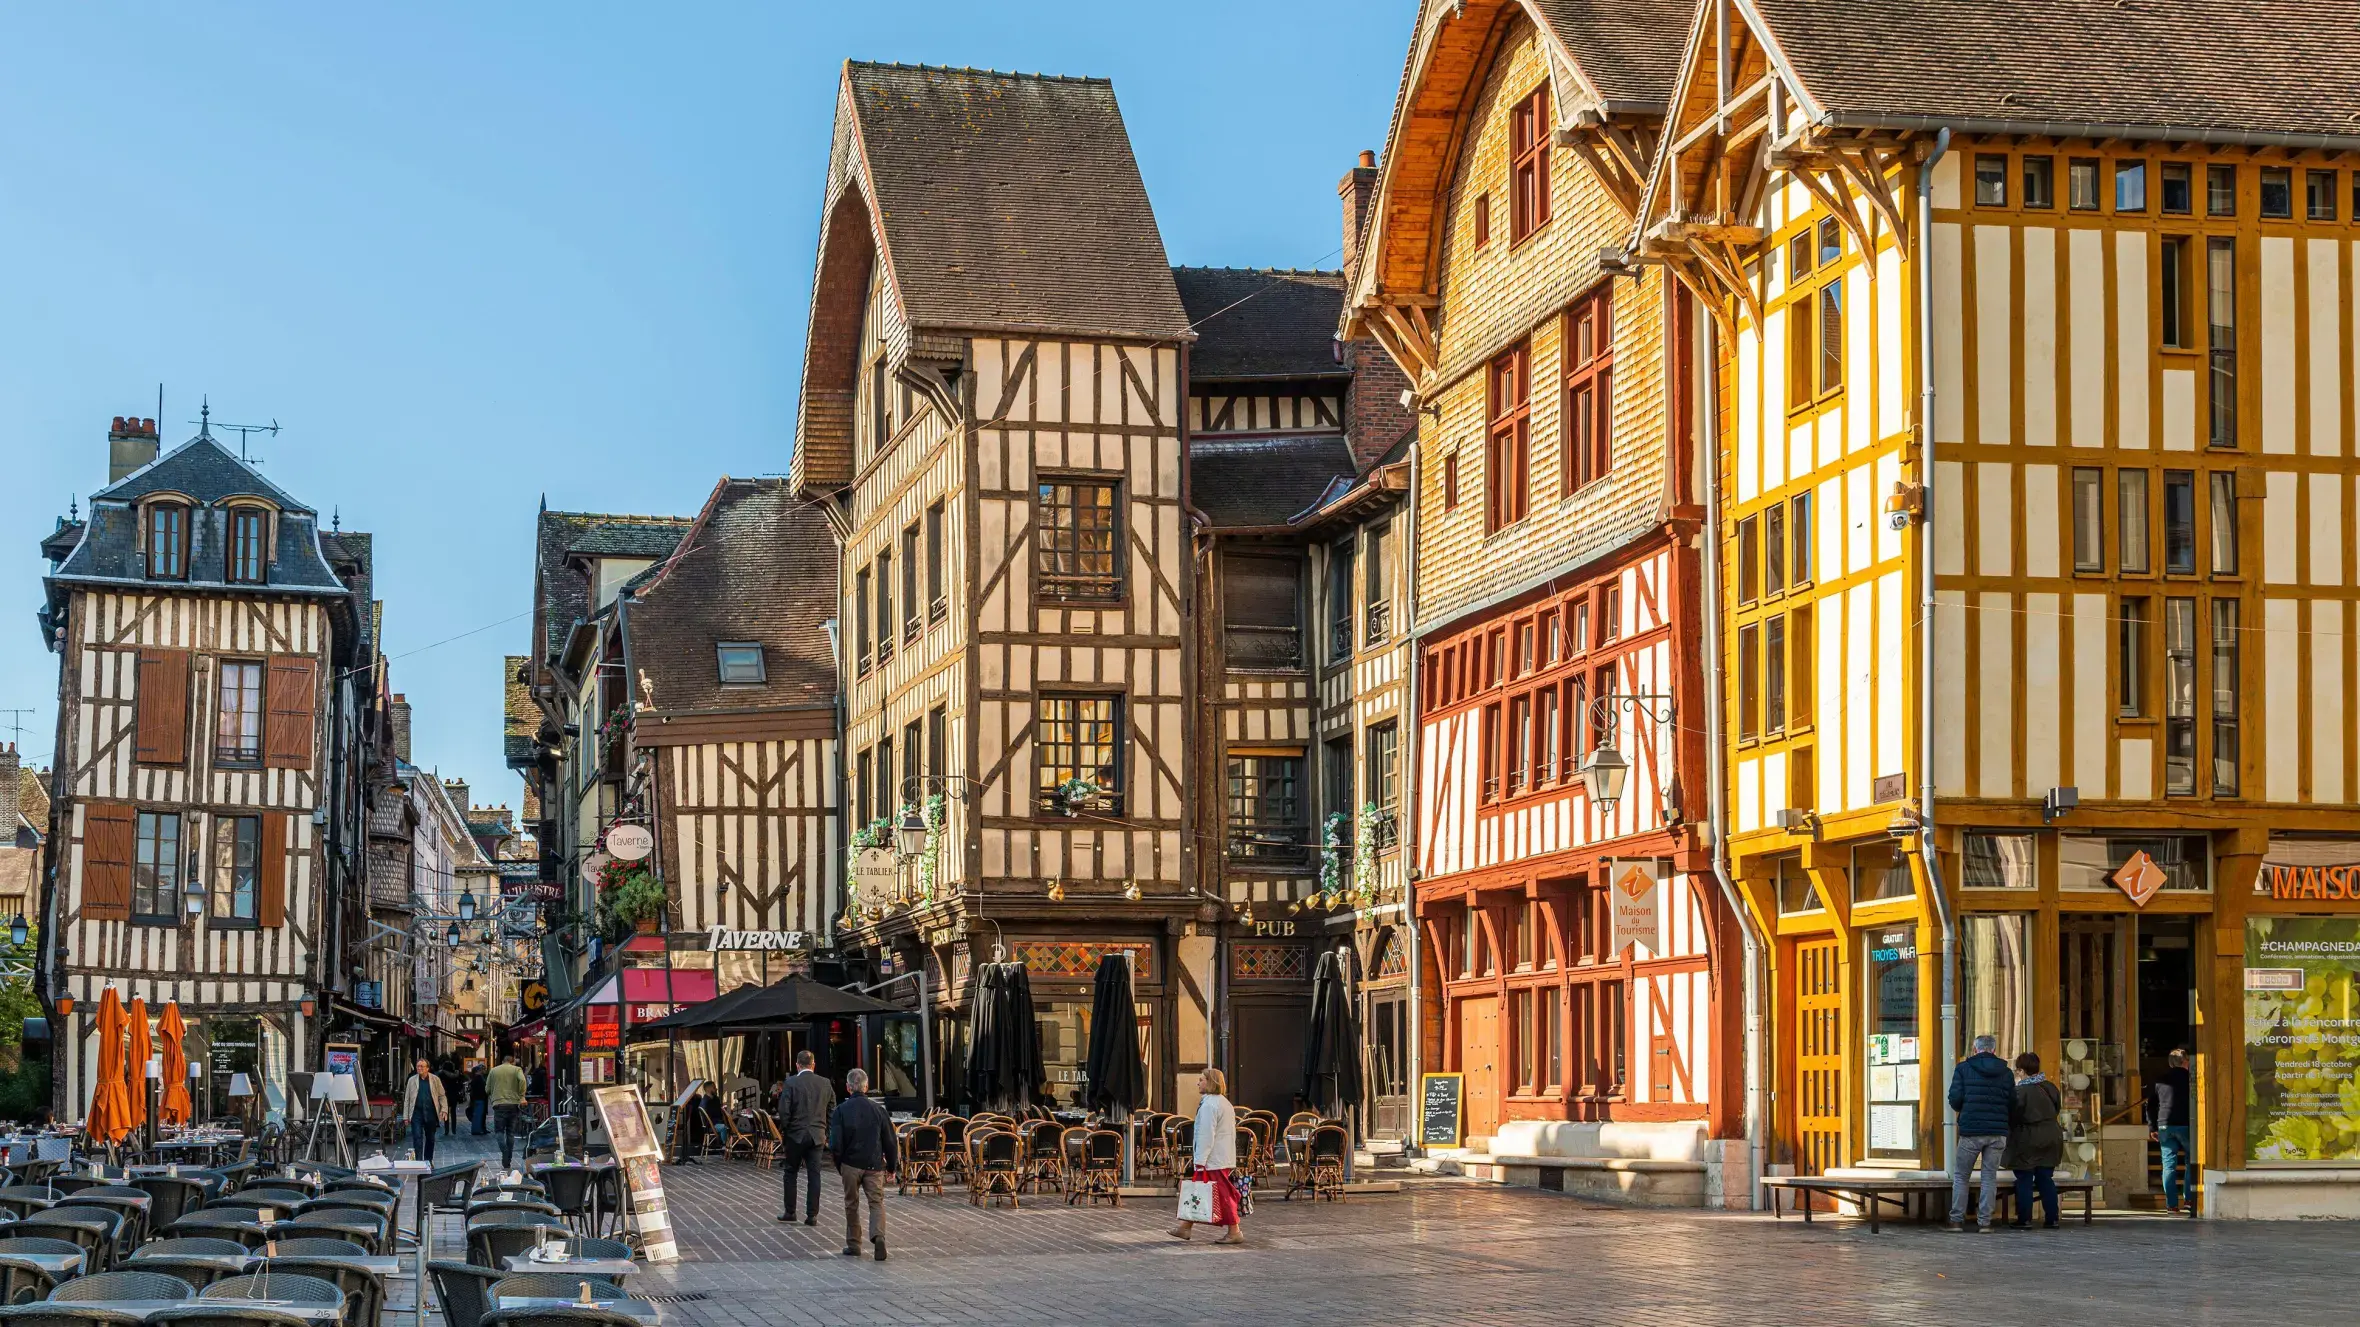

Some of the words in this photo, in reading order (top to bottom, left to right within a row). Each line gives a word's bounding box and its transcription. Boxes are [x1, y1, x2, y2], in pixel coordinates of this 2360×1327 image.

[610, 834, 649, 846] Taverne
[856, 866, 865, 876] LE
[866, 866, 894, 876] TABLIER
[1619, 905, 1652, 916] Maison
[1631, 917, 1640, 925] du
[1255, 920, 1296, 937] PUB
[1616, 924, 1656, 935] Tourisme
[705, 924, 803, 952] TAVERNE
[1882, 933, 1904, 944] GRATUIT
[1871, 948, 1899, 962] TROYES
[2304, 1034, 2319, 1044] de
[2275, 1060, 2310, 1068] Vendredi
[2312, 1060, 2320, 1068] 18
[2321, 1060, 2352, 1068] octobre
[1058, 1070, 1068, 1082] LE
[2281, 1071, 2303, 1081] partir
